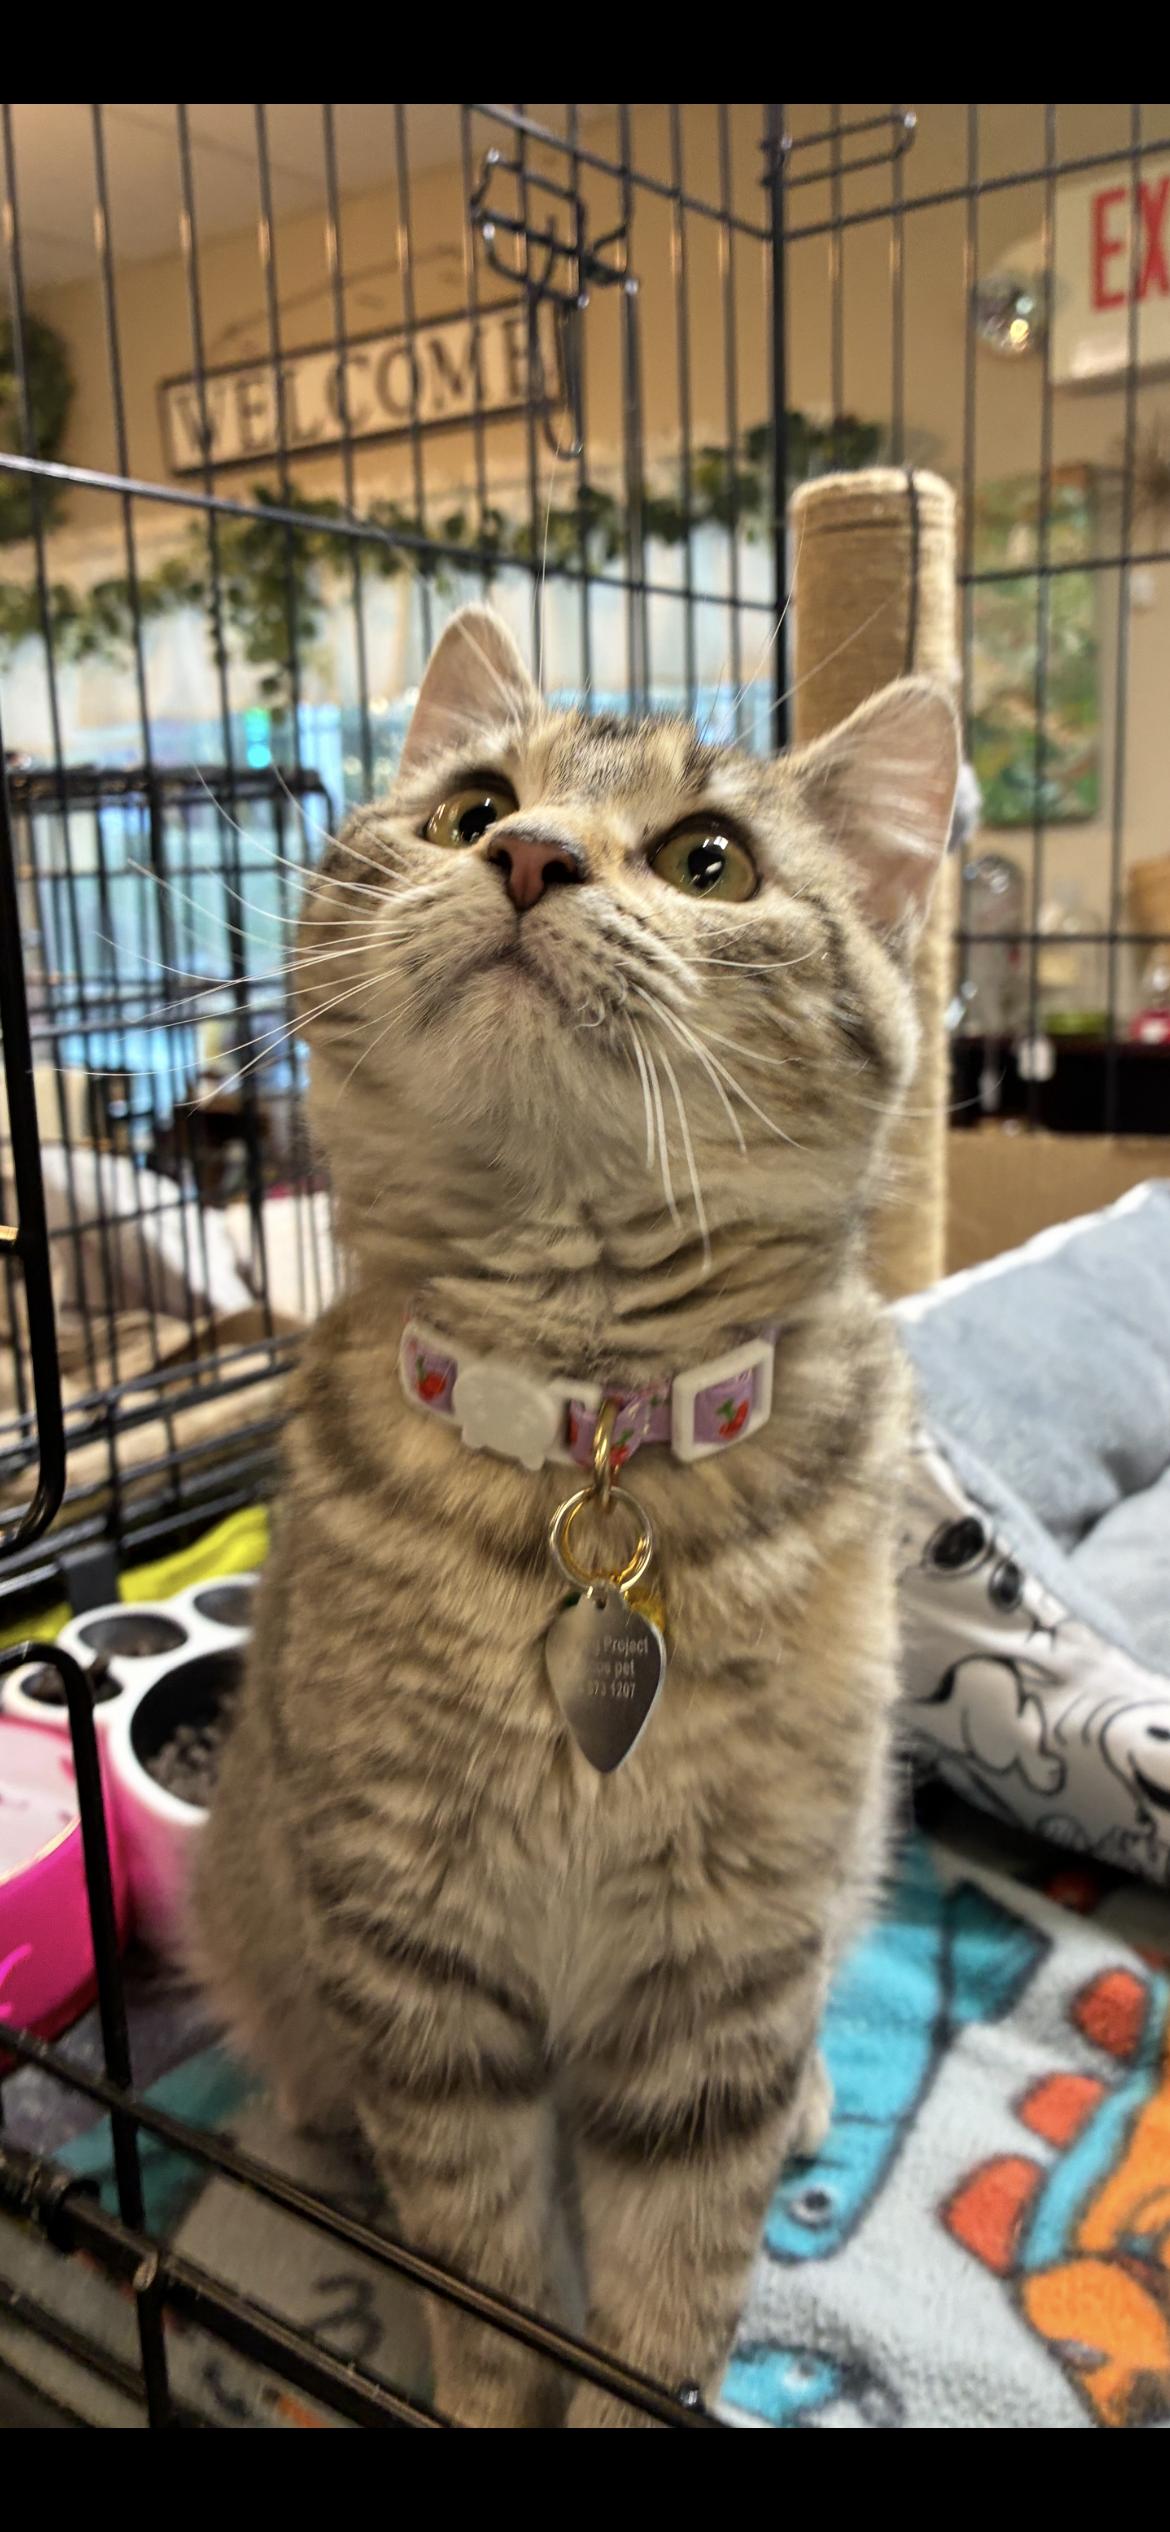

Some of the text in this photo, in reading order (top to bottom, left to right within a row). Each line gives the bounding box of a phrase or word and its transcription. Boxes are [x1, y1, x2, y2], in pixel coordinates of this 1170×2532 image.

[603, 1634, 649, 1657] Project
[615, 1658, 635, 1679] pet
[610, 1679, 636, 1699] 1207
